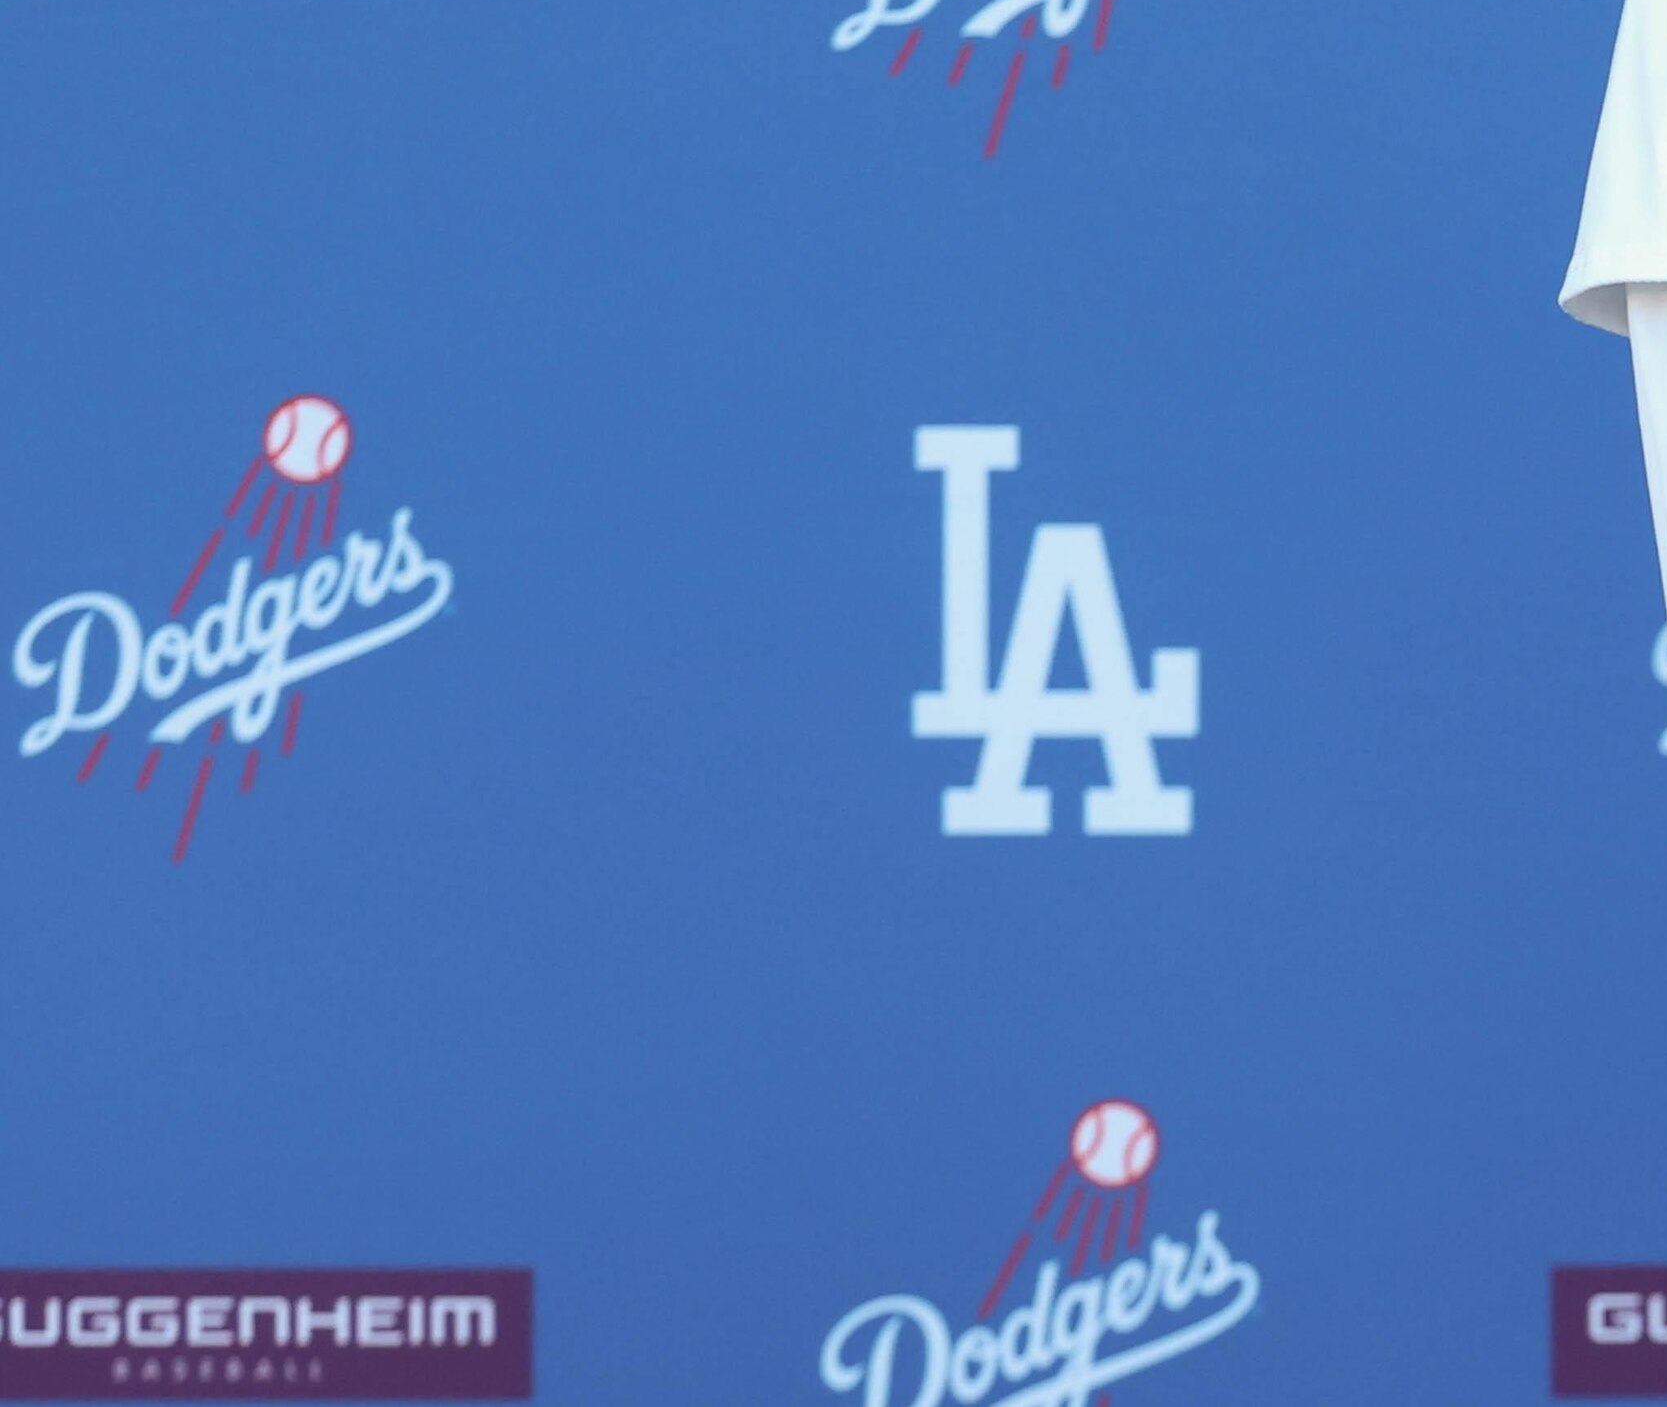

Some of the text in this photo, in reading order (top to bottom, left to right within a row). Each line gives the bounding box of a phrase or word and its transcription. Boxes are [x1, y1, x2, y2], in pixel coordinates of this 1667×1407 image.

[13, 508, 452, 756] Dodgers
[912, 425, 1200, 836] LA
[0, 1296, 496, 1347] UGGENHEIM
[111, 1356, 324, 1384] BASEBALL
[822, 1213, 1258, 1407] Dodgers
